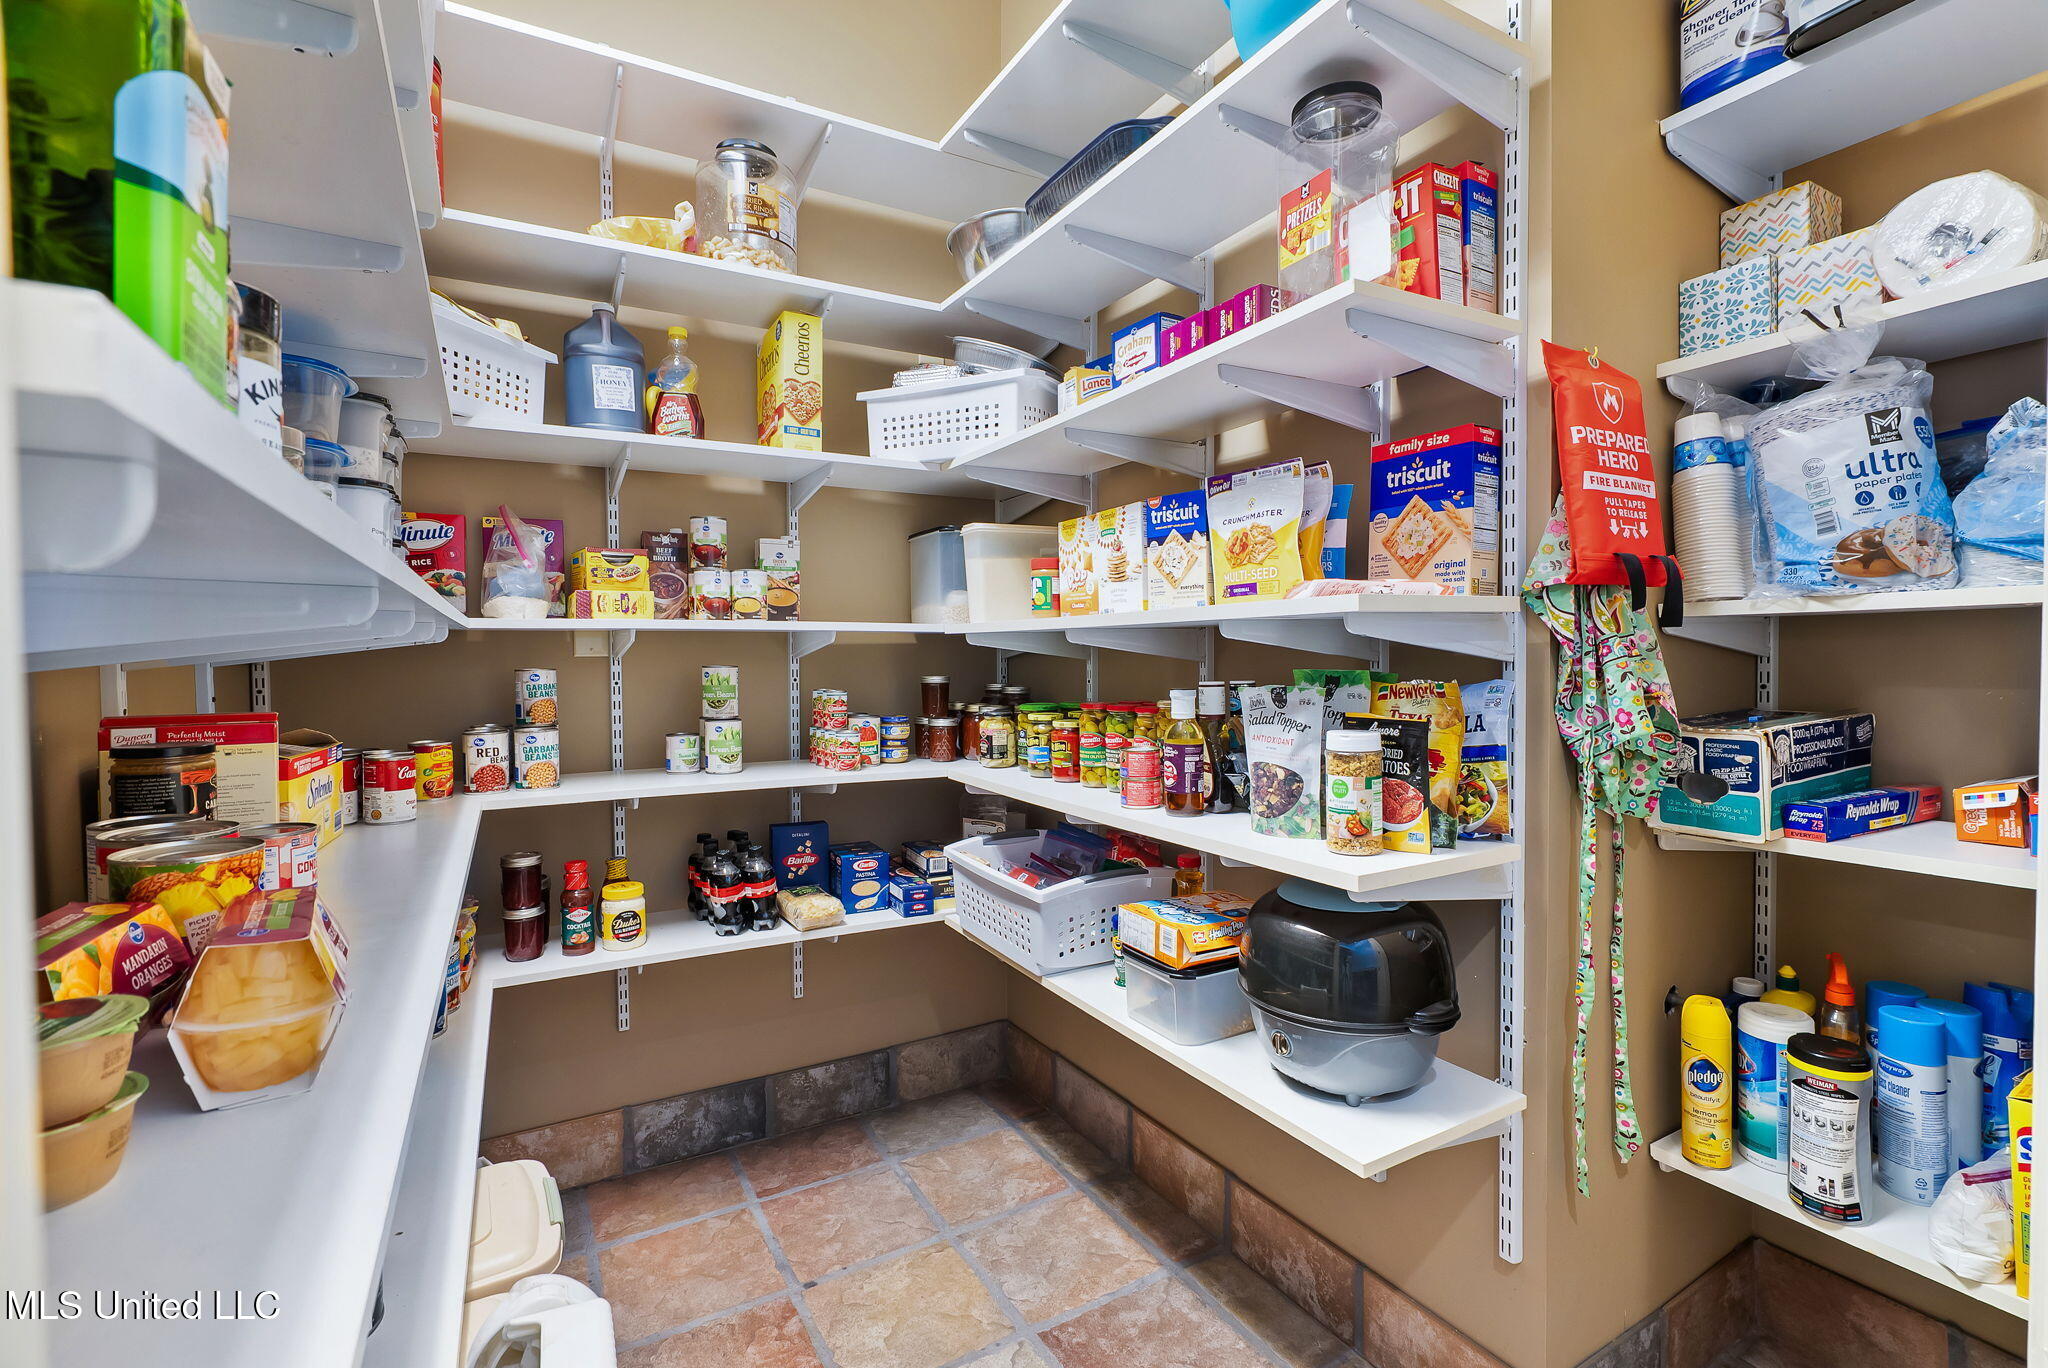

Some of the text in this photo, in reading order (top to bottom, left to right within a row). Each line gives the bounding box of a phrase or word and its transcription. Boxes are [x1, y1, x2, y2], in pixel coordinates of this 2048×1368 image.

[1683, 7, 1729, 36] Shower,
[1683, 35, 1691, 45] &
[1694, 23, 1715, 38] Tile
[1474, 166, 1490, 178] family
[1478, 175, 1488, 184] size
[1473, 191, 1493, 206] triscuit
[753, 205, 774, 217] RINDS
[1286, 197, 1322, 231] PRETZELS
[794, 322, 810, 376] Cheerios
[1117, 335, 1153, 358] Graham
[1082, 378, 1111, 392] Lance
[1478, 427, 1495, 437] family
[1389, 433, 1450, 455] family size
[1570, 426, 1650, 454] PREPARED
[1477, 452, 1497, 464] triscuit
[1597, 449, 1639, 472] HERO
[1845, 449, 1923, 480] ultra
[1386, 458, 1451, 488] triscuit
[1590, 475, 1652, 494] FIRE BLANKET
[1854, 471, 1922, 491] paper plates
[1604, 497, 1646, 510] PULL TAPES
[1150, 502, 1200, 525] triscuit
[1222, 508, 1283, 526] CRUNCHMASTER
[1606, 507, 1648, 520] TO RELEASE
[400, 524, 455, 543] Minute
[411, 558, 433, 568] RICE
[652, 555, 677, 563] BROTH
[1433, 559, 1466, 571] original
[1223, 566, 1278, 583] MULTI-SEED
[1434, 570, 1453, 578] made
[1783, 567, 1798, 576] 330
[528, 690, 554, 699] BEANS
[1248, 710, 1312, 734] Salad Topper
[113, 733, 153, 744] Duncan
[166, 731, 203, 740] Perfectly
[1252, 733, 1295, 747] ANTIOXIDANT
[1792, 727, 1806, 739] 3000
[476, 747, 500, 758] RED
[1705, 742, 1741, 750] PROFESSIONAL
[1793, 736, 1844, 755] PROFESSIONAL PLASTIC
[524, 753, 553, 762] BEANS
[1381, 760, 1411, 776] TOES
[1788, 759, 1816, 774] FOOD WRAP
[307, 775, 333, 810] Splenda
[1712, 804, 1731, 813] (3000
[1712, 811, 1727, 819] (279
[1790, 809, 1824, 819] Reynolds
[1845, 797, 1900, 821] Reynolds Wrap
[1788, 814, 1808, 824] Wrap
[1811, 819, 1824, 827] 75
[1962, 808, 1979, 834] Gre
[1977, 808, 1988, 827] Valu
[1790, 831, 1823, 840] EVERYDAY
[786, 856, 817, 866] Barilla
[188, 914, 217, 928] PICKED
[566, 921, 592, 930] COCKTAIL
[612, 916, 641, 930] Duke's
[1208, 926, 1233, 941] Healthy
[121, 937, 169, 976] MANDARIN
[131, 954, 174, 990] ORANGES
[1687, 1069, 1724, 1086] pledge
[1807, 1077, 1835, 1090] WEIMAN
[1887, 1081, 1910, 1099] cleaner
[1692, 1106, 1718, 1118] lemon
